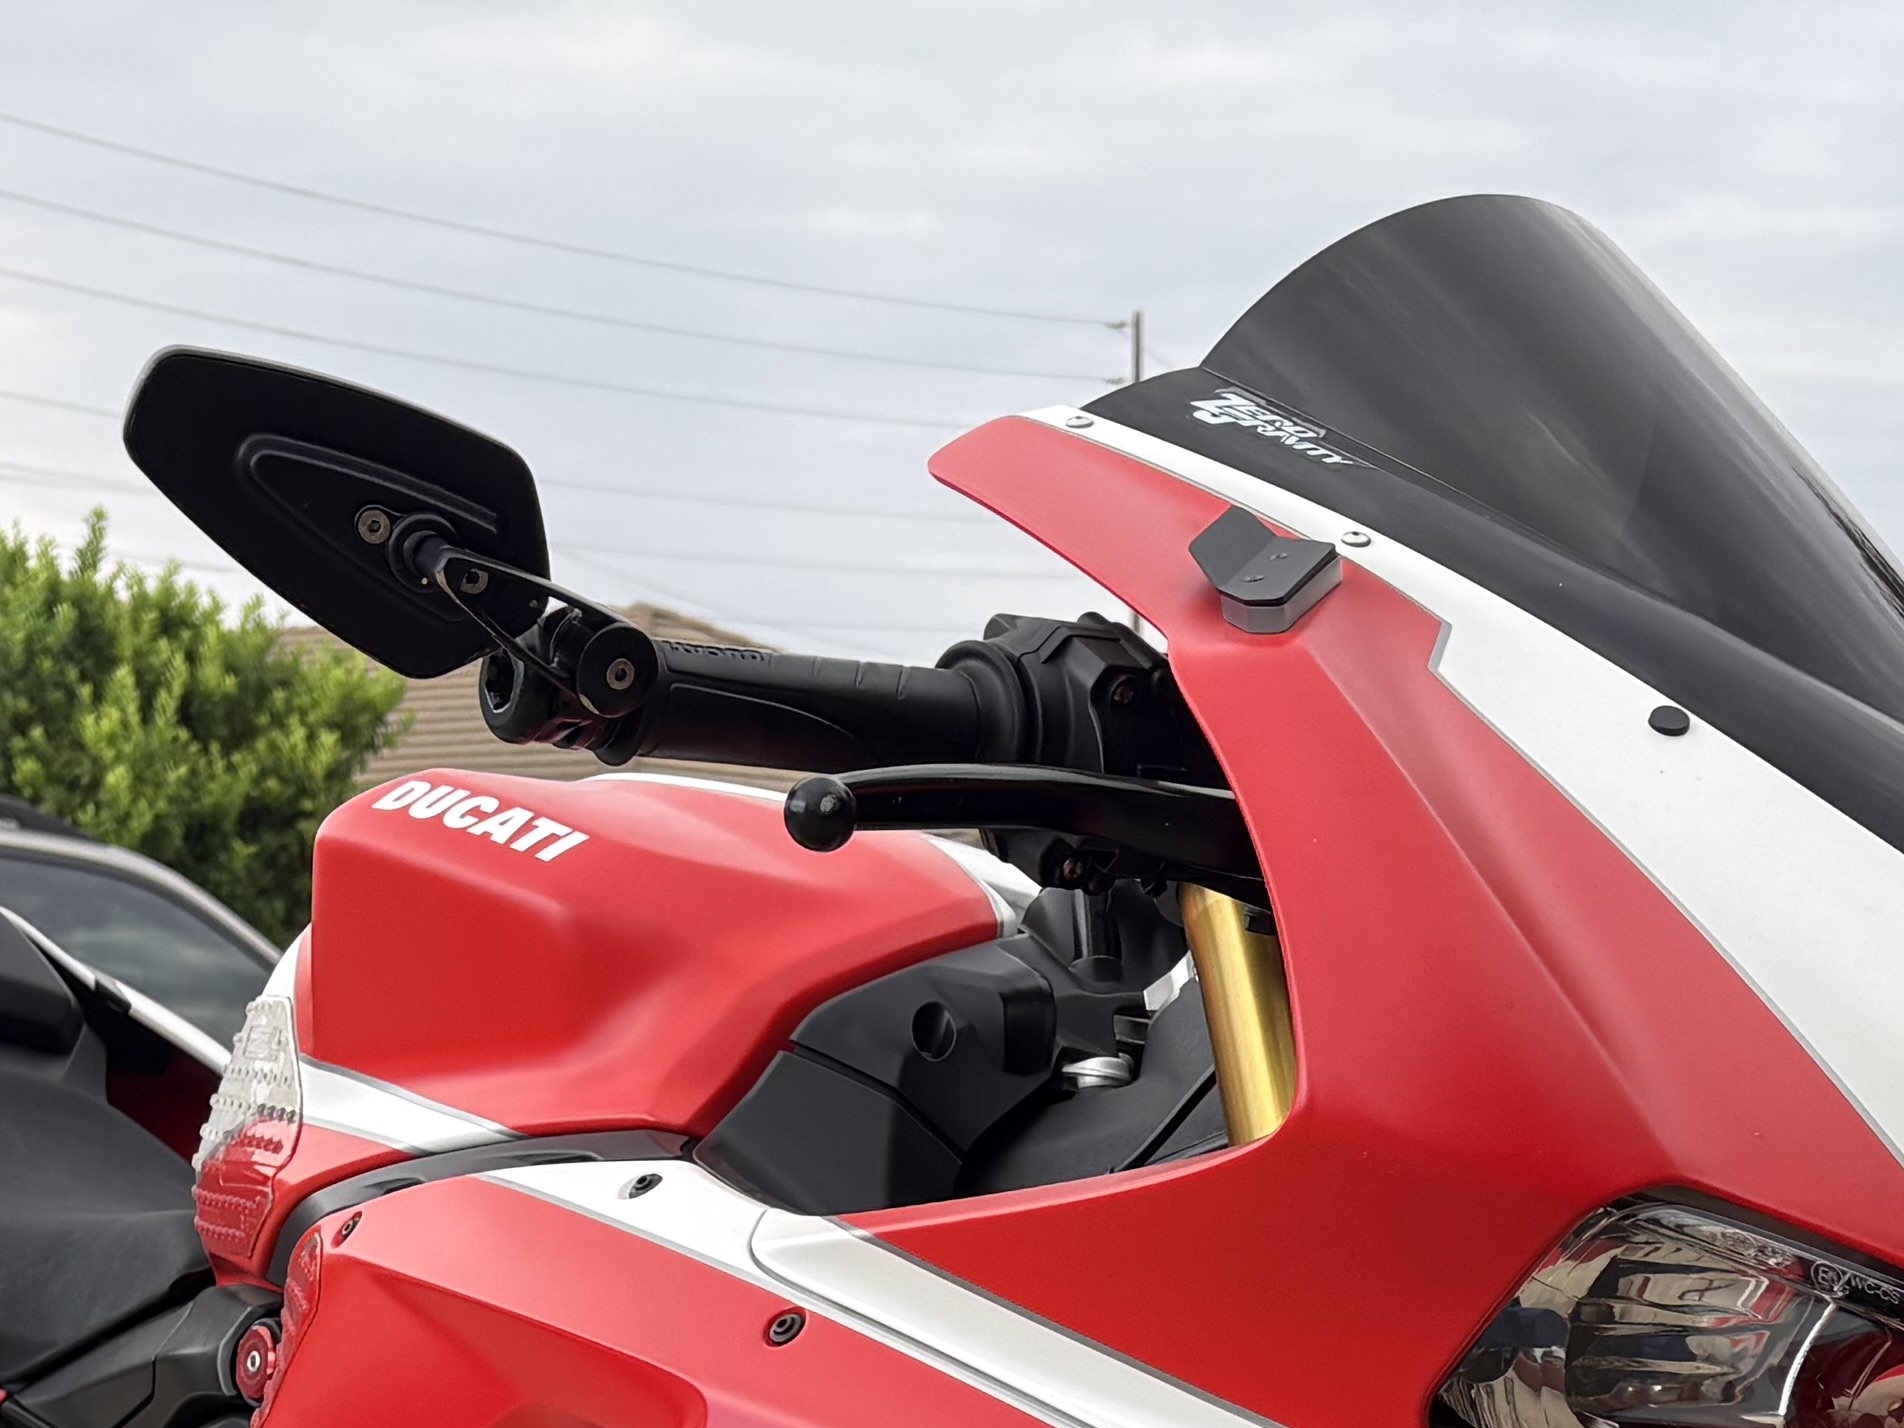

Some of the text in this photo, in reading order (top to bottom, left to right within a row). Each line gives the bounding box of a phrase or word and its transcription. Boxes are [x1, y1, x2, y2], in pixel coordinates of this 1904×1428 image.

[1190, 389, 1324, 440] ZERO
[1193, 410, 1358, 467] GRAVITY
[371, 779, 588, 863] DUCATI
